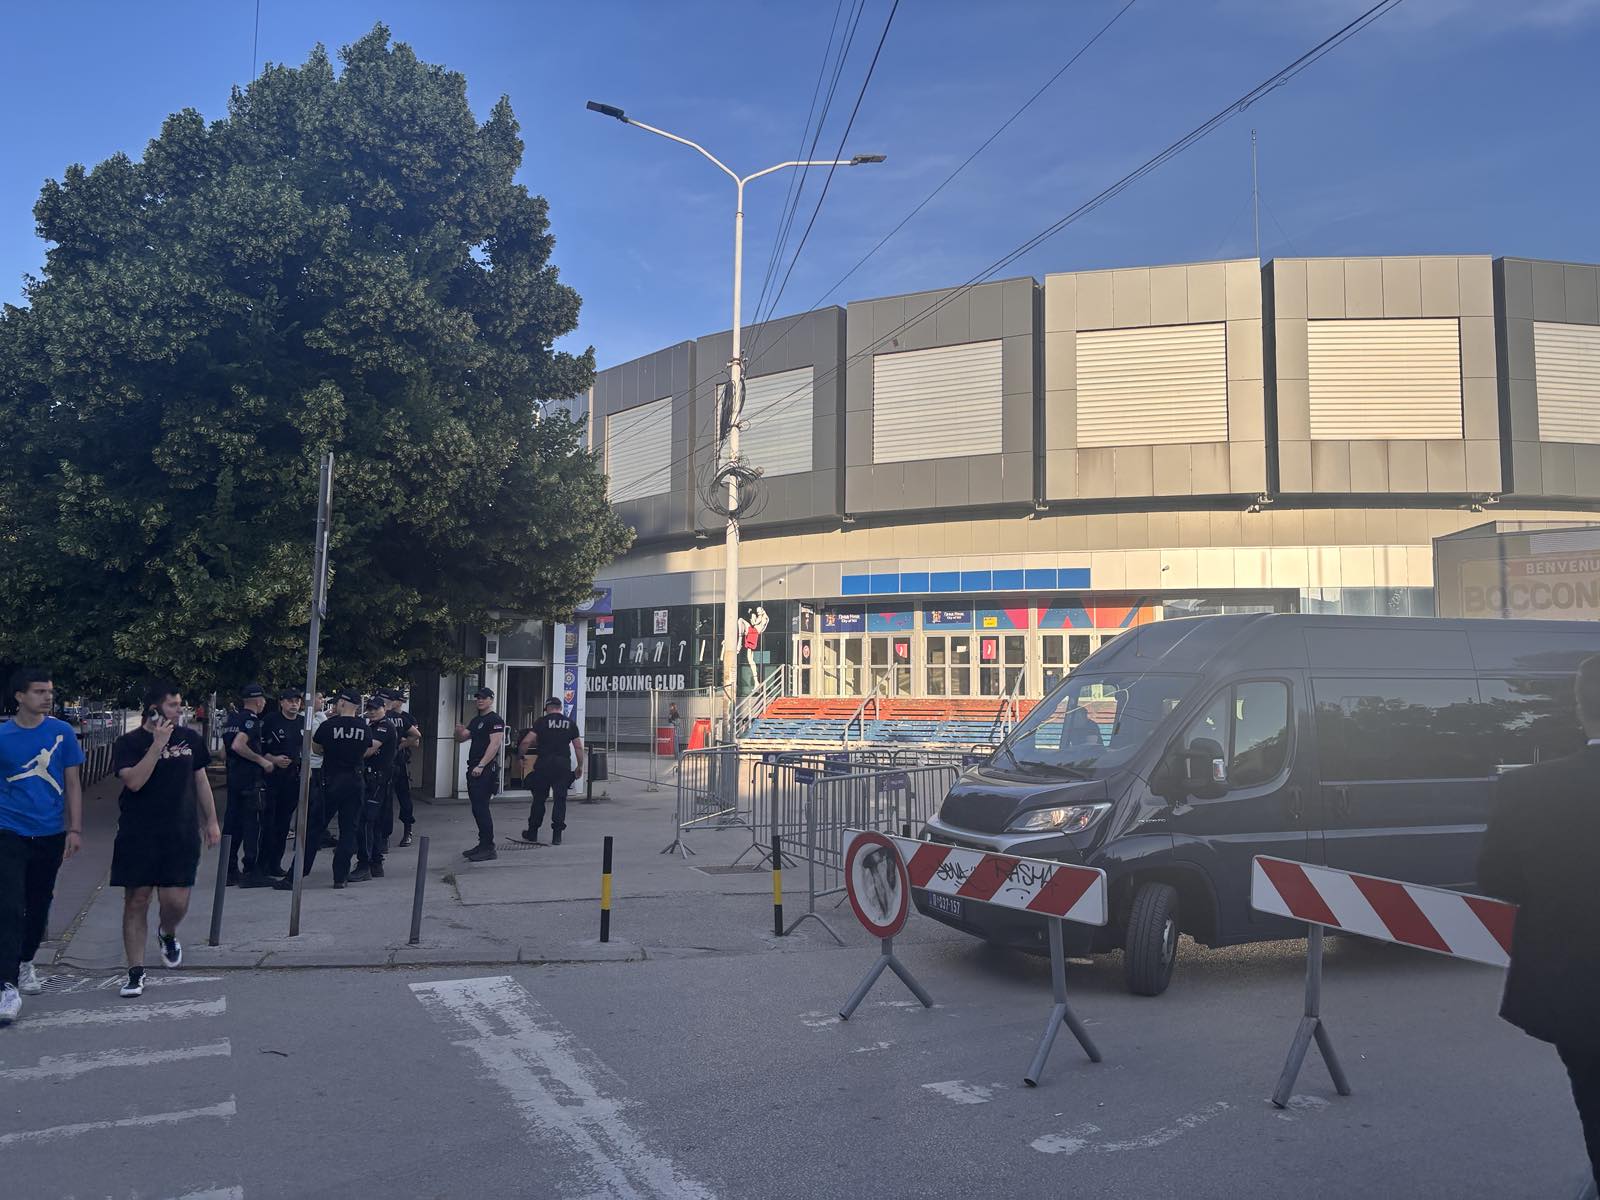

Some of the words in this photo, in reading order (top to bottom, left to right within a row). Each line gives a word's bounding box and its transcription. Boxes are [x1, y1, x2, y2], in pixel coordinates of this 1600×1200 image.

[1526, 559, 1600, 574] BENVENU
[587, 640, 725, 665] STANTI
[585, 675, 652, 692] KICK-BOXING
[655, 674, 685, 691] CLUB
